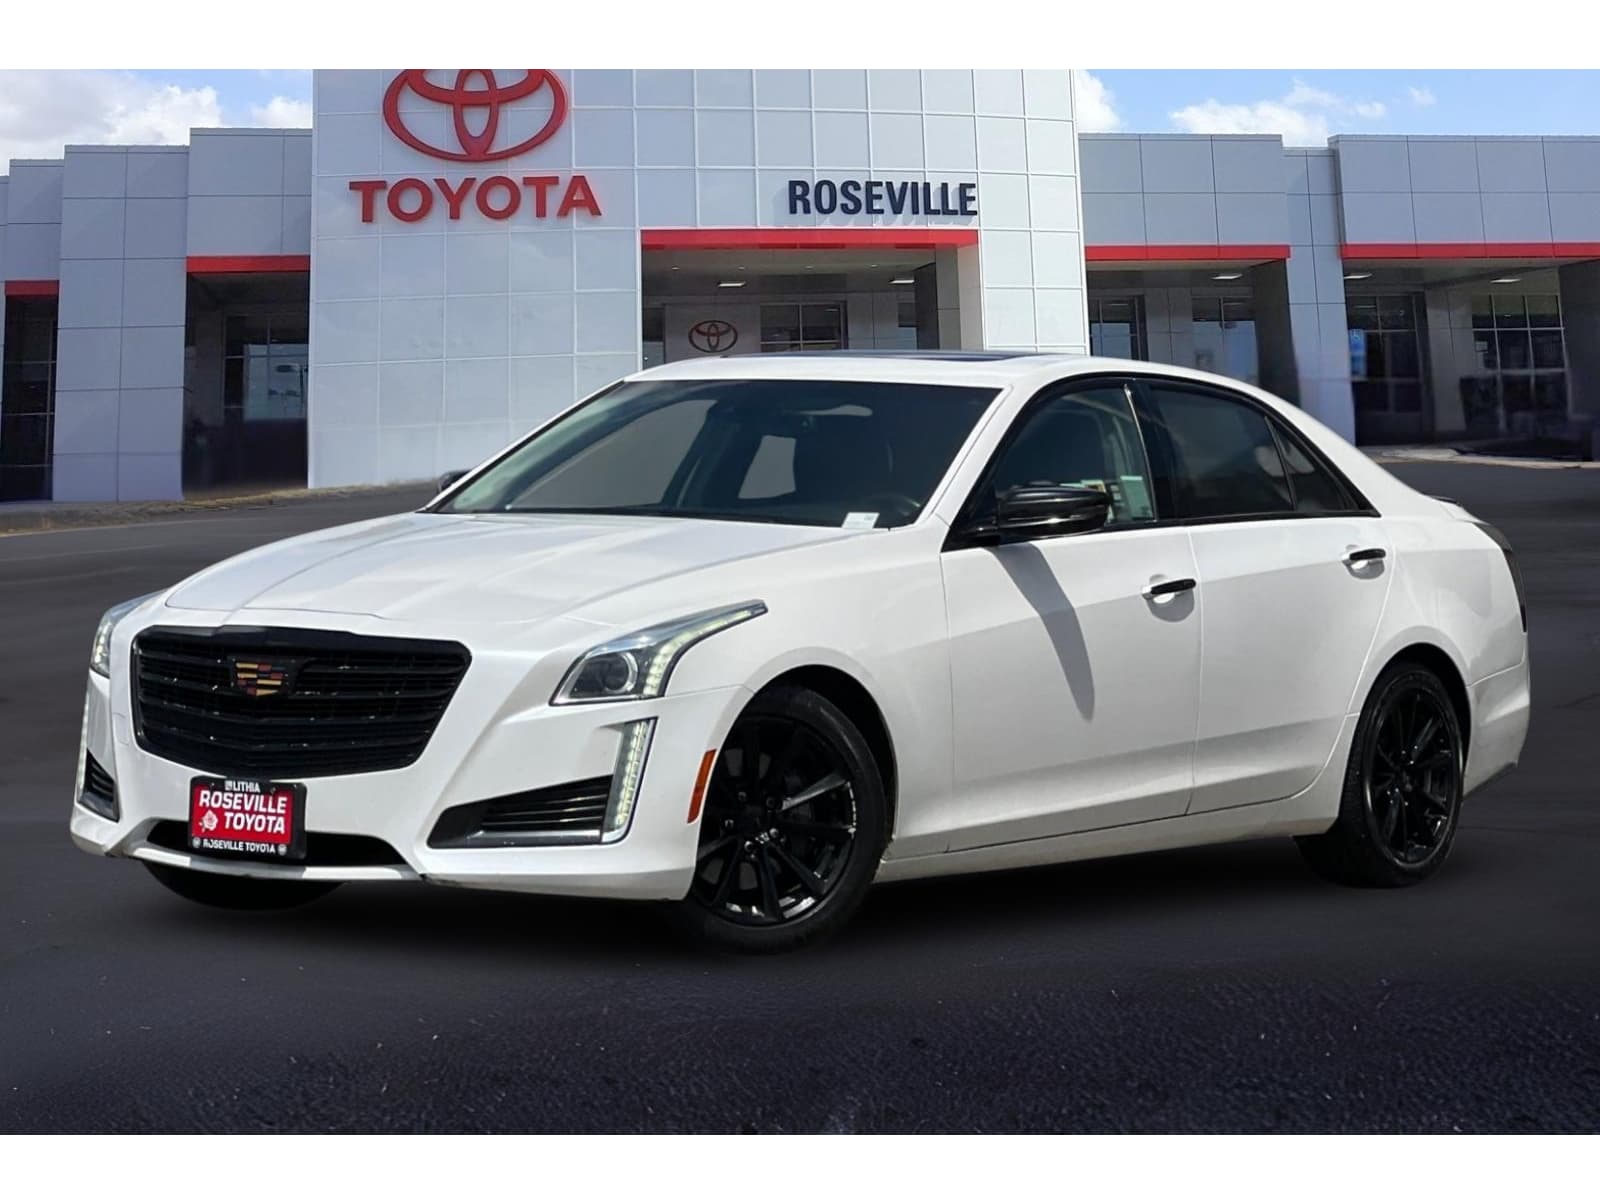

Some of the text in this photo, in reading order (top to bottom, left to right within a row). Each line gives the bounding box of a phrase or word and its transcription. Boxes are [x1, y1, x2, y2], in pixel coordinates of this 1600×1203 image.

[349, 175, 602, 223] TOYOTA
[788, 179, 978, 216] ROSEVILLE
[233, 781, 261, 793] LITHIA
[199, 790, 287, 814] ROSEVILLE
[224, 812, 285, 834] TOYOTA
[203, 839, 276, 854] ROSEVILLE TOYOTA
